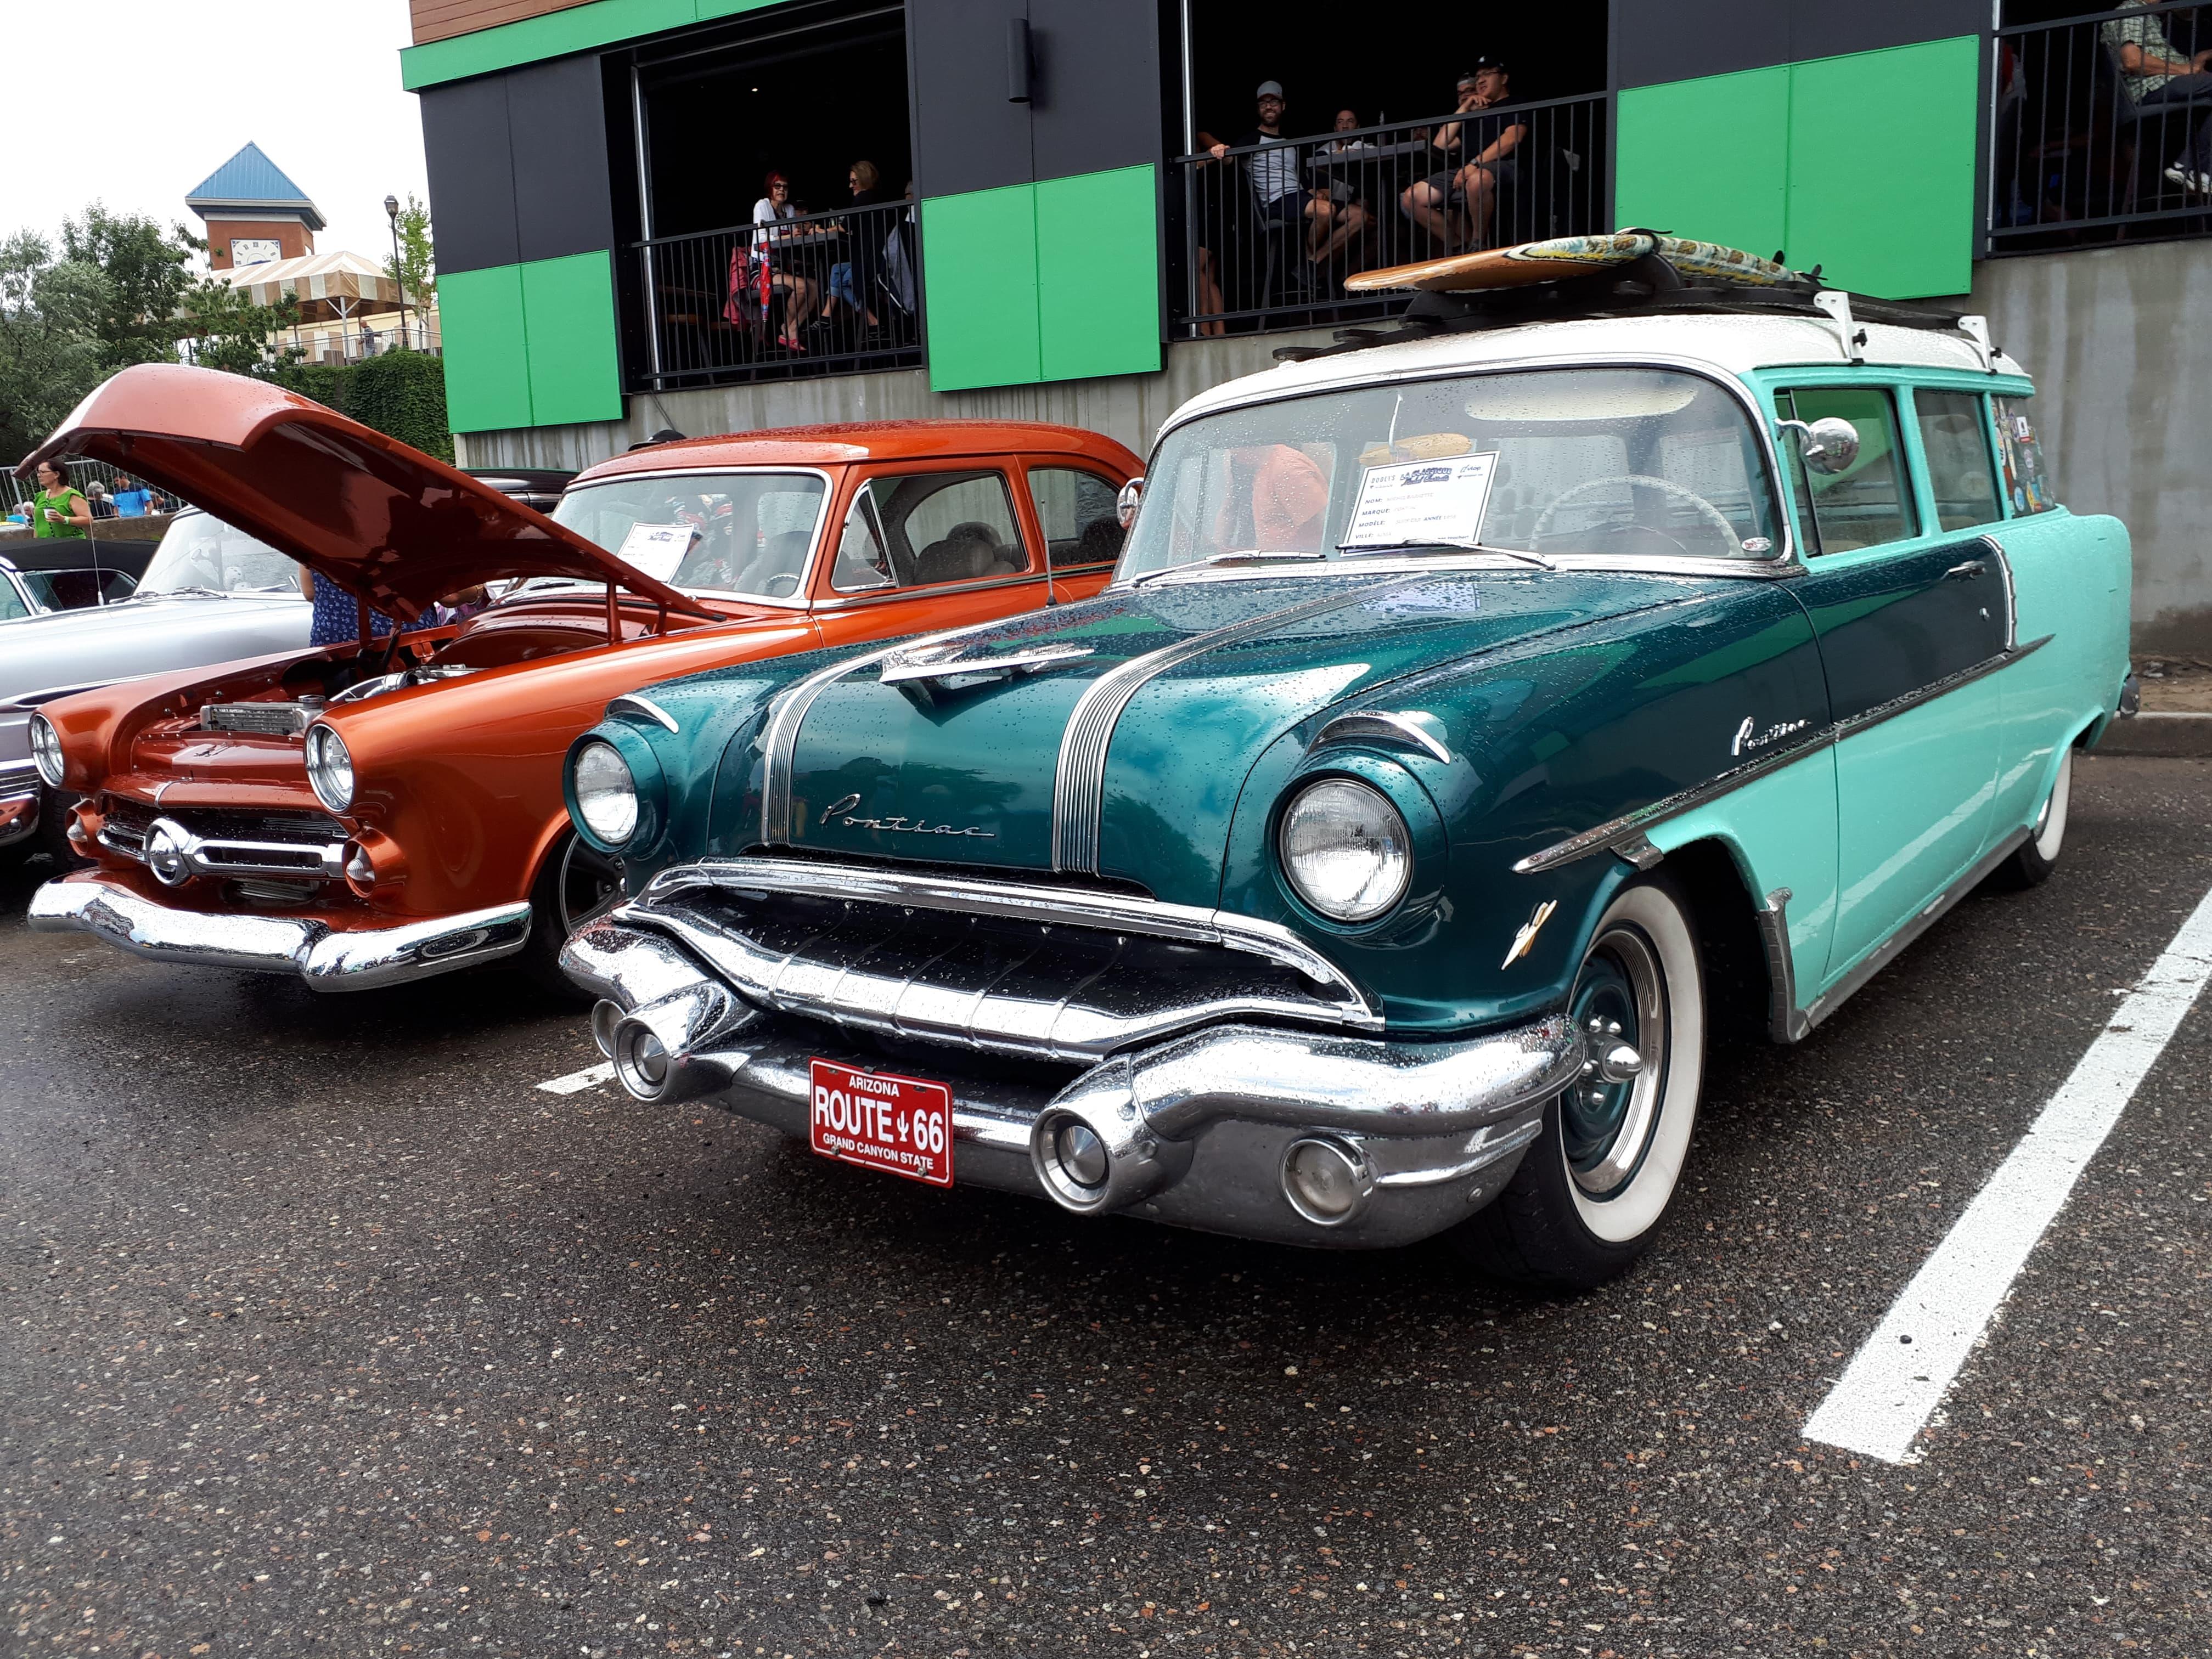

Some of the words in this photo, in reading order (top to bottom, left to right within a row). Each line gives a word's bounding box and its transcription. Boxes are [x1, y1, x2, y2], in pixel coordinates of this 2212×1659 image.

[819, 793, 996, 838] Pontiac
[849, 1075, 899, 1097] ARIZONA
[815, 1085, 894, 1143] ROUTE
[913, 1109, 943, 1154] 66
[823, 1132, 855, 1151] GRAND
[857, 1143, 898, 1161] CANYON
[899, 1153, 934, 1170] STATE
